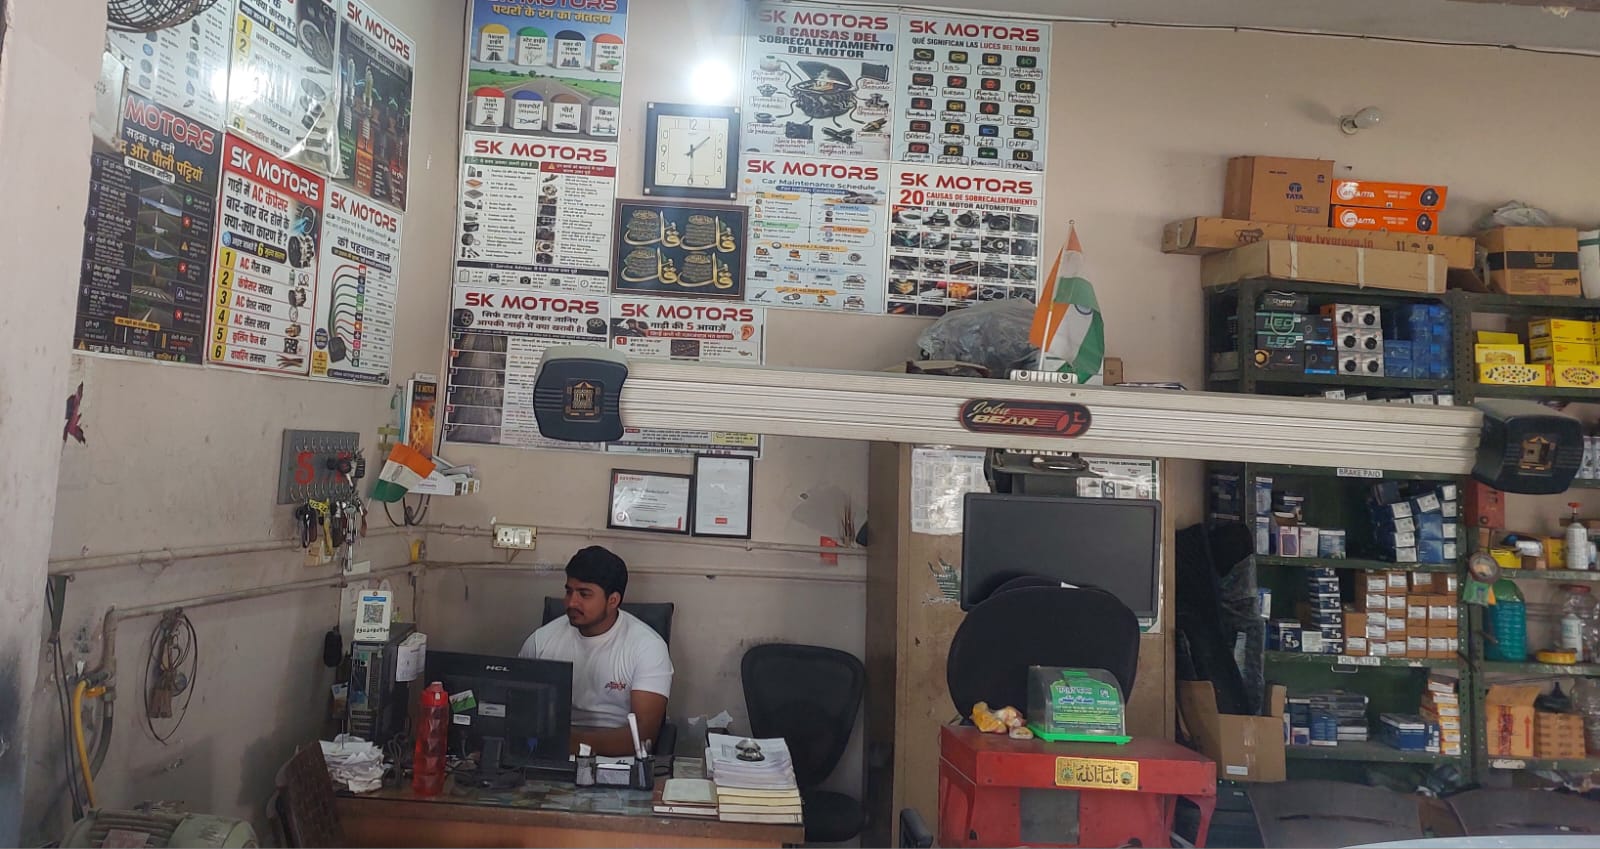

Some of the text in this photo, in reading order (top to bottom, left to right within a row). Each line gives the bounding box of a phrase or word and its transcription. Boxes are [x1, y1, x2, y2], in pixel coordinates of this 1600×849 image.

[524, 6, 535, 17] के
[538, 8, 554, 19] रंग
[557, 10, 571, 21] का
[574, 12, 612, 24] मतलब
[760, 9, 889, 30] SK MOTORS
[347, 1, 410, 61] SK MOTORS
[776, 27, 879, 43] 8 CAUSAS DEL
[909, 20, 1040, 42] SK MOTORS
[759, 35, 894, 52] SOBRECALENTAMIENTO
[912, 37, 925, 45] QUÉ
[927, 38, 964, 48] SIGNIFICAN
[966, 41, 978, 49] LAS
[980, 42, 1001, 50] LUCES
[788, 46, 864, 58] DEL MOTOR
[124, 95, 215, 155] MOTORS
[689, 119, 697, 130] 12
[126, 127, 175, 155] सड़क पर बनी
[130, 142, 149, 161] और
[152, 150, 174, 171] पीली
[474, 140, 608, 163] SK MOTORS
[660, 144, 667, 157] 9
[717, 148, 723, 160] 3
[231, 146, 252, 173] SK
[256, 158, 318, 201] MOTORS
[660, 161, 666, 172] 8
[716, 165, 722, 174] 4
[747, 159, 879, 181] SK MOTORS
[687, 175, 694, 186] 6
[704, 175, 710, 186] 5
[779, 179, 835, 188] Maintenance
[837, 183, 876, 191] Schedule
[901, 172, 1033, 195] SK MOTORS
[228, 177, 242, 196] गाड़ी
[252, 185, 263, 202] AC
[900, 190, 924, 205] 20
[926, 192, 953, 200] CAUSAS
[965, 195, 1038, 206] SOBRECALENTAMIENTO
[226, 195, 257, 219] बार-बार
[259, 205, 269, 223] बंद
[270, 211, 282, 228] होने
[283, 216, 290, 230] के
[331, 191, 347, 213] SK
[350, 200, 397, 233] MOTORS
[976, 203, 1021, 212] AUTOMOTRIZ
[224, 214, 255, 235] क्या-क्या
[256, 224, 276, 243] कारण
[258, 243, 264, 257] 6
[337, 236, 349, 248] की
[350, 241, 375, 257] पहचान
[225, 252, 231, 265] 1
[240, 257, 250, 270] AC
[222, 271, 229, 285] 2
[220, 290, 227, 304] 3
[235, 294, 245, 308] AC
[465, 292, 600, 315] SK MOTORS
[218, 308, 225, 322] 4
[234, 313, 243, 326] AC
[482, 310, 578, 325] सिर्फ टायर देखकर जानिए
[621, 303, 754, 322] SK MOTORS
[477, 319, 505, 328] आपकी
[507, 320, 525, 330] गाड़ी
[536, 323, 549, 331] क्या
[552, 323, 574, 333] खराबी
[650, 320, 669, 330] गाड़ी
[672, 321, 684, 331] की
[687, 322, 694, 331] 5
[1264, 318, 1294, 328] LED
[216, 327, 224, 341] 5
[1267, 336, 1296, 345] LED
[215, 345, 221, 359] 6
[967, 401, 1010, 418] John
[972, 414, 1038, 426] BEAN
[1339, 468, 1361, 476] BRAKE
[1356, 657, 1379, 665] FILTER
